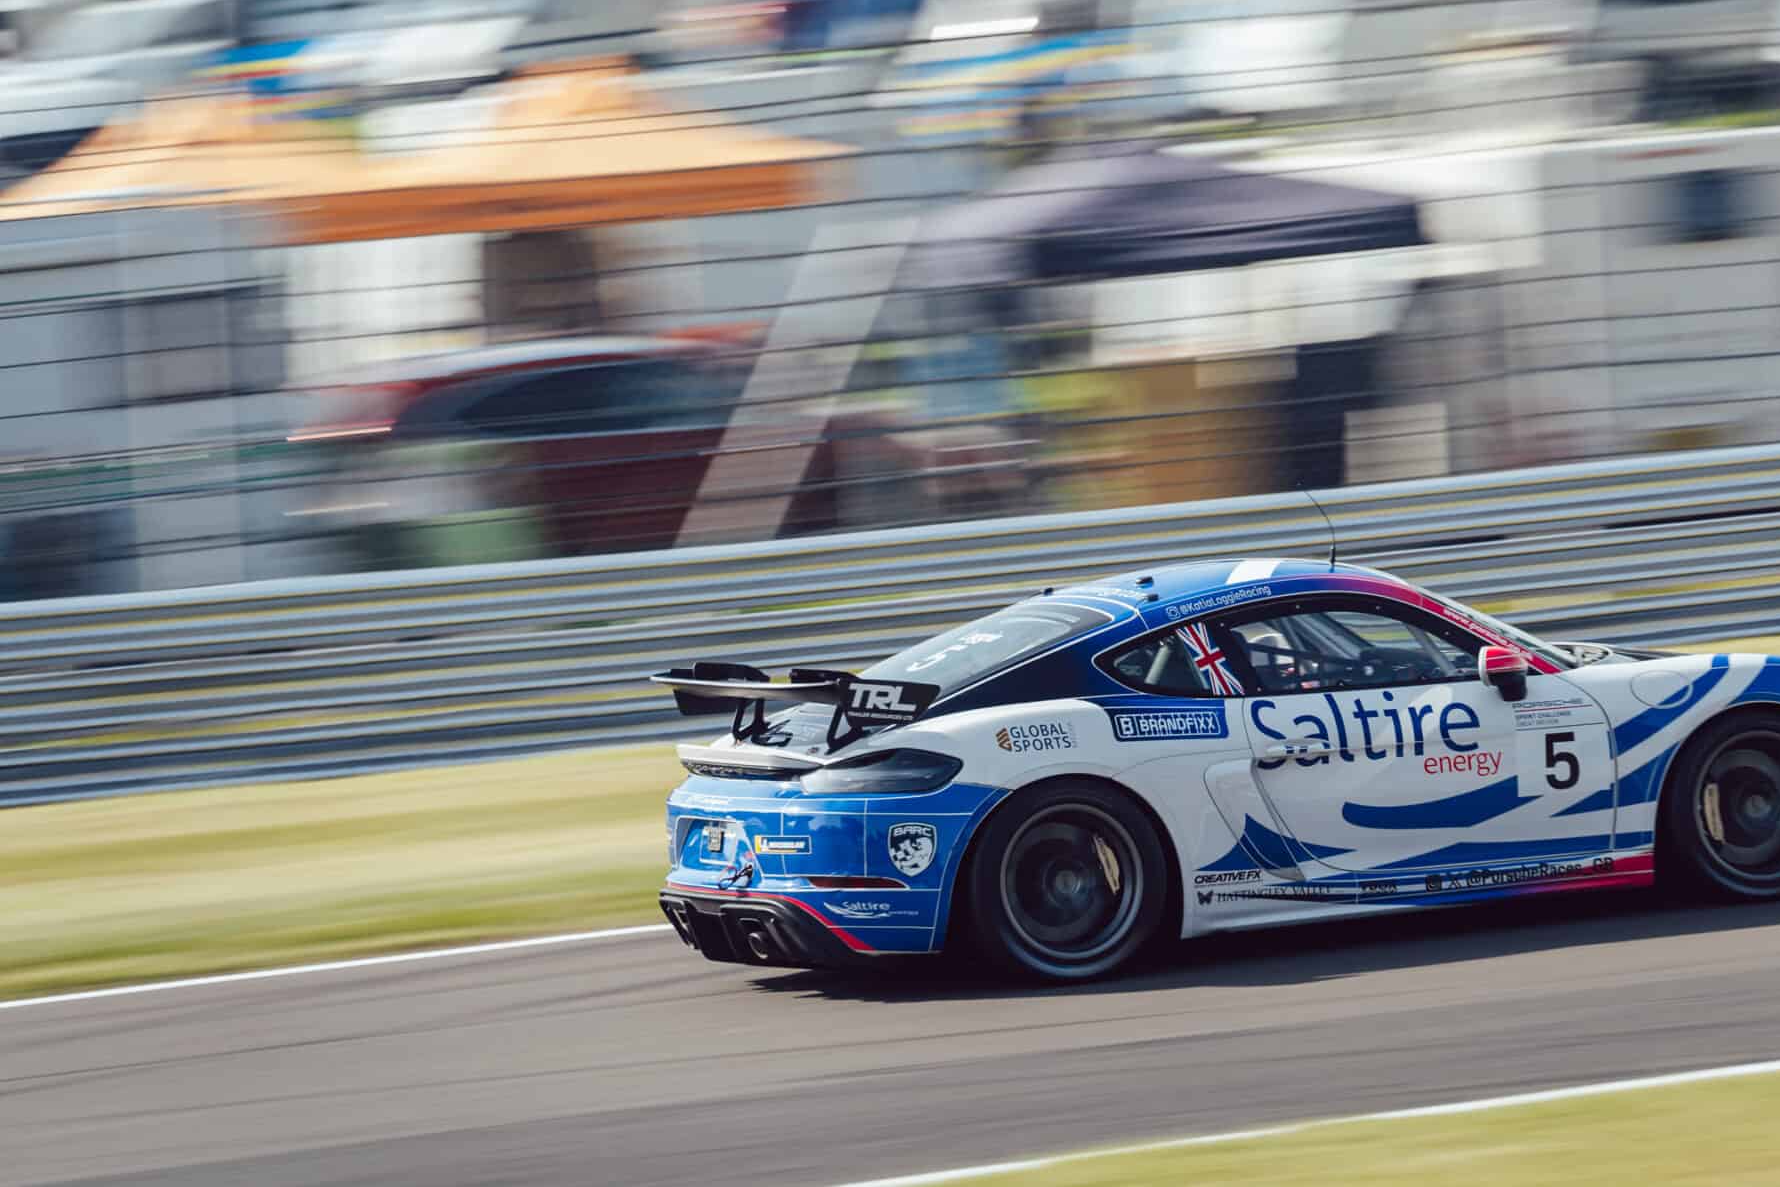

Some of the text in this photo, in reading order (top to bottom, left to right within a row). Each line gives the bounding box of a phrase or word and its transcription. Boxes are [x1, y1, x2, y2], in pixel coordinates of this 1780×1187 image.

[848, 683, 917, 711] TRL
[1010, 722, 1068, 739] GLOBAL
[1139, 715, 1216, 733] BRANDFIXX
[1250, 691, 1481, 770] Saltire
[1013, 735, 1072, 752] SPORTS
[1424, 751, 1503, 777] energy
[1545, 731, 1580, 790] 5
[894, 826, 932, 837] BARC
[1194, 870, 1247, 885] CREATIVE
